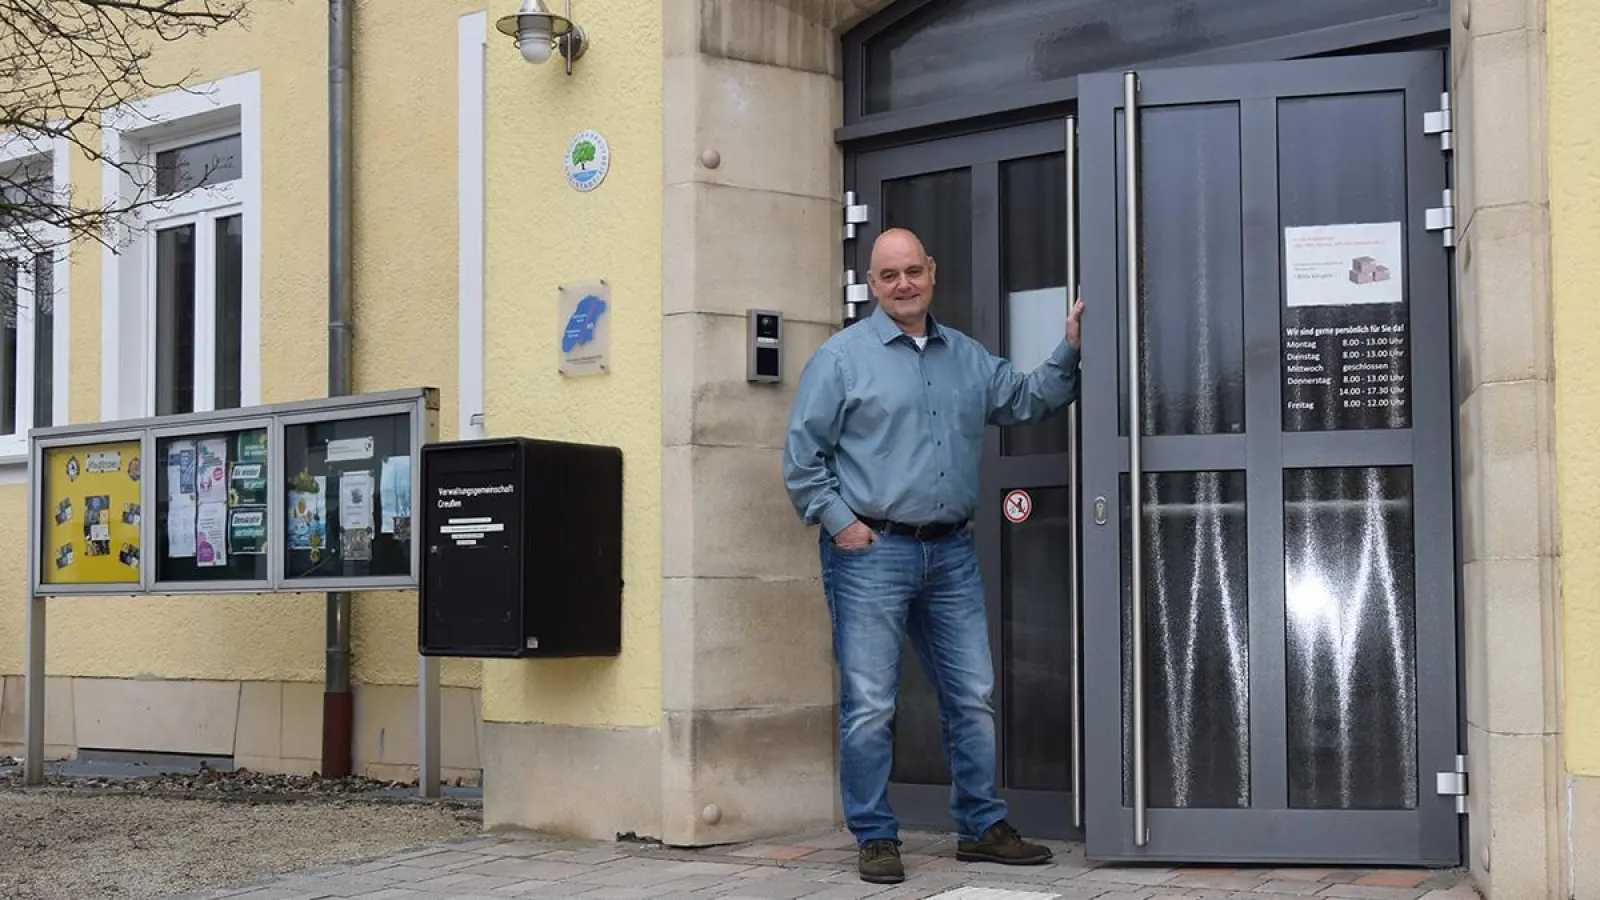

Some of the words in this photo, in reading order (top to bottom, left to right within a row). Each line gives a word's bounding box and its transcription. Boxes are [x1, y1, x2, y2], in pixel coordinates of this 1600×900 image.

[1287, 328, 1299, 336] Wir
[1315, 328, 1333, 336] gerne
[1335, 325, 1369, 336] persönlich
[1370, 325, 1380, 333] für
[1381, 324, 1391, 332] Sie
[1392, 324, 1404, 332] da!
[1287, 341, 1316, 349] Montag
[1342, 339, 1360, 347] 8.00
[1366, 338, 1388, 346] 13.00
[1287, 353, 1320, 361] Dienstag
[1342, 351, 1360, 359] 8.00
[1366, 350, 1388, 358] 13.00
[1288, 364, 1324, 372] Mittwoch
[1343, 363, 1388, 372] geschlossen
[1343, 375, 1360, 383] 8.00
[1367, 374, 1388, 382] 13.00
[1340, 388, 1360, 396] 14.00
[1367, 387, 1388, 395] 17.30
[1288, 402, 1314, 410] Freitag
[1343, 400, 1360, 408] 8.00
[1367, 399, 1388, 407] 12.00
[438, 484, 514, 496] Verwaltungsgemeinschaft
